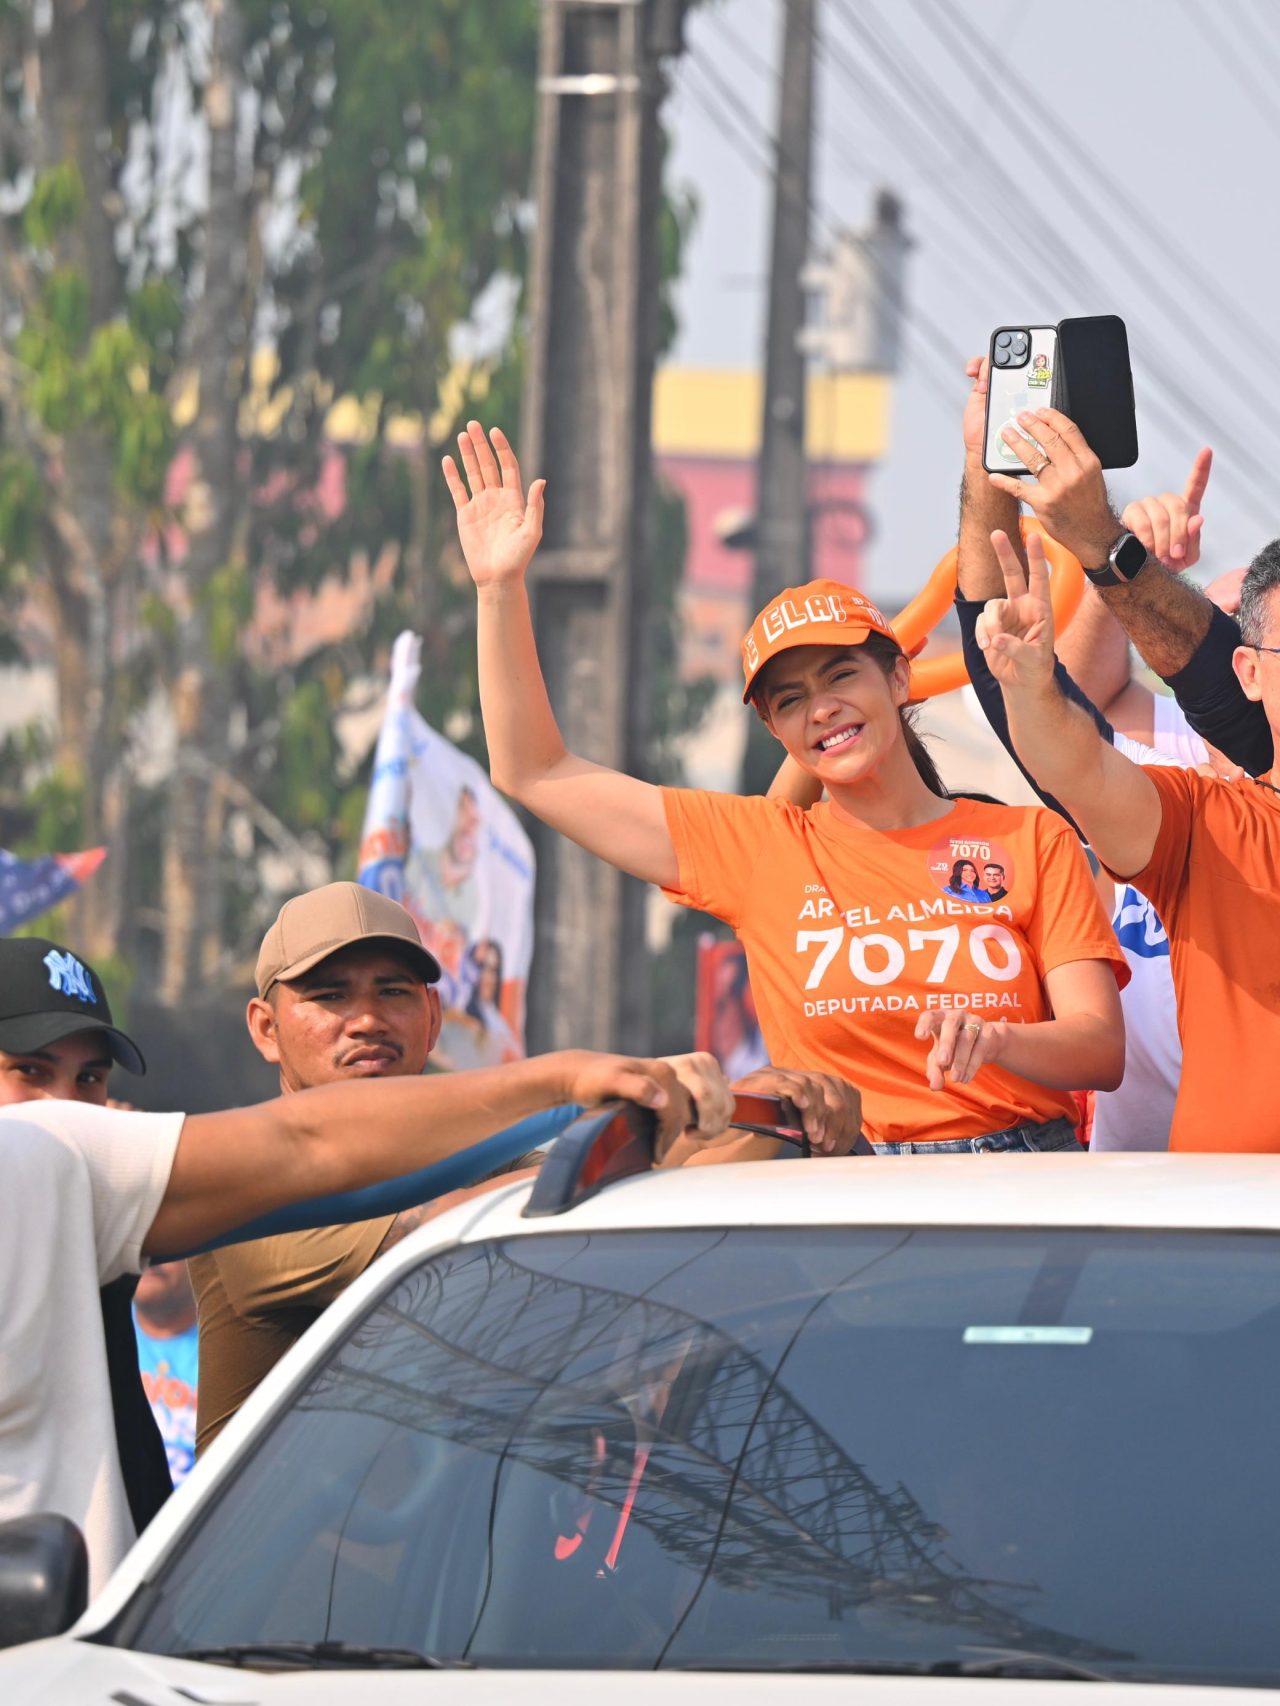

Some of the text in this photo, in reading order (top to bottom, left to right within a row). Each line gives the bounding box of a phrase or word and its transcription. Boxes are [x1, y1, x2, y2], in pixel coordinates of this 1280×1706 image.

[762, 594, 847, 644] ELA!
[949, 844, 991, 861] 7070
[886, 897, 1014, 922] ALMEIDA
[796, 924, 1021, 990] 7070
[804, 992, 1022, 1018] DEPUTADA FEDERAL
